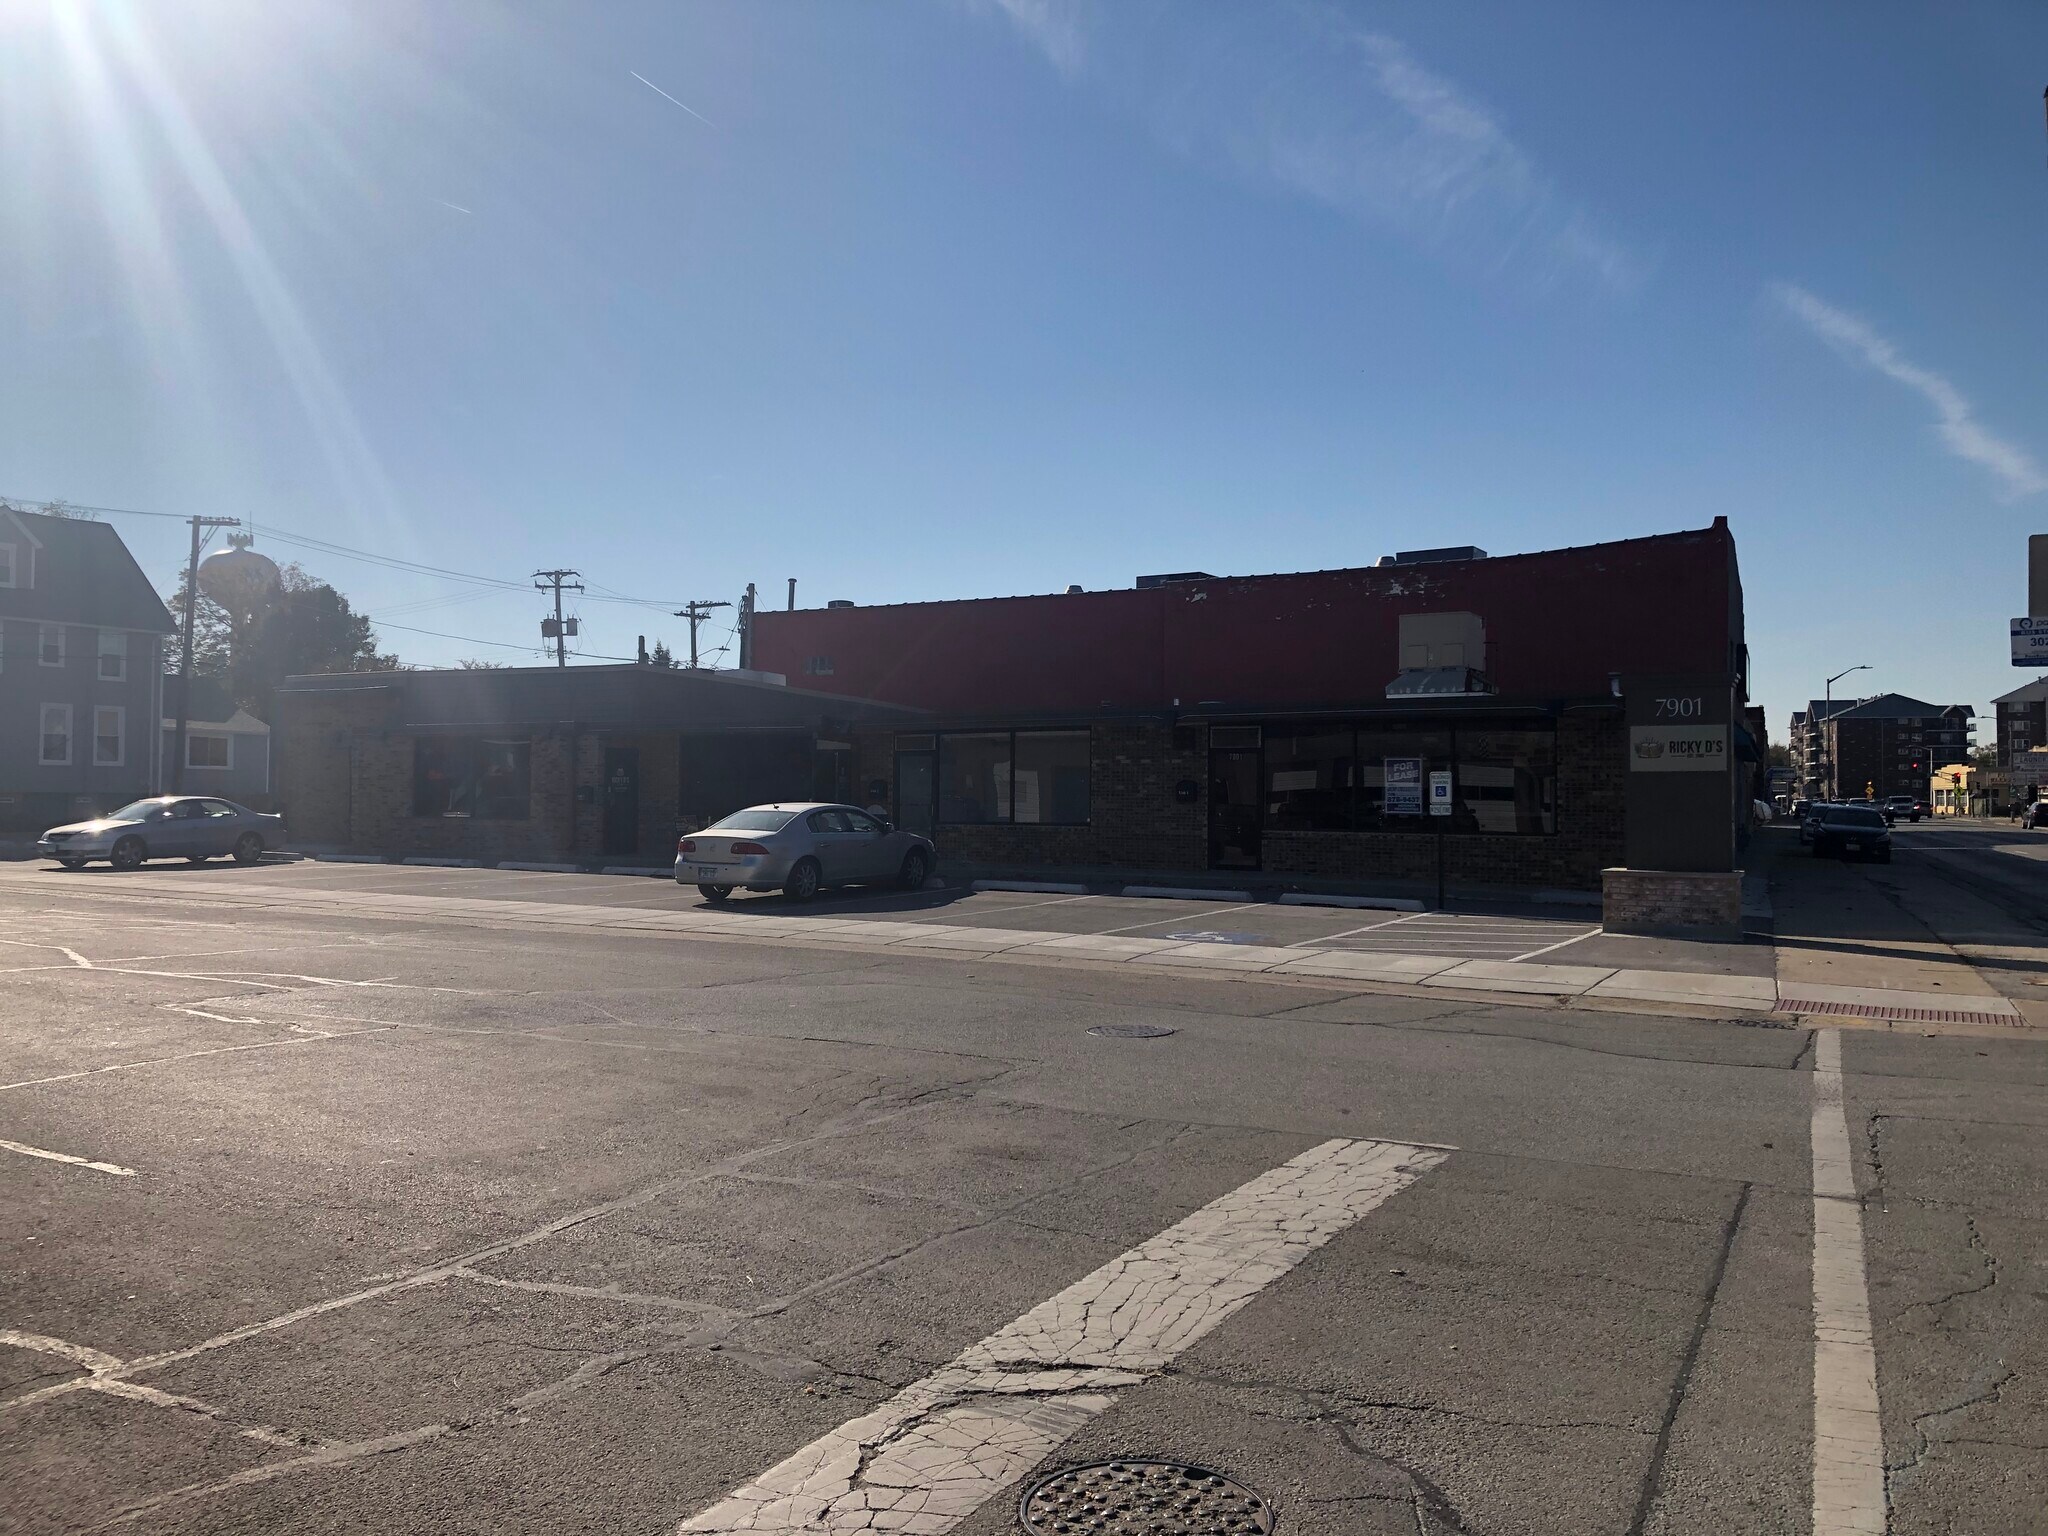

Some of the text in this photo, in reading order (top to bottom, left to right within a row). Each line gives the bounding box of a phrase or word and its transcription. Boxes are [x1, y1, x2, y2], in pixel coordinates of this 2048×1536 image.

[1655, 697, 1702, 717] 7901
[1669, 740, 1723, 754] RICKY D'S
[1394, 761, 1413, 771] FOR
[1388, 770, 1419, 781] LEASE
